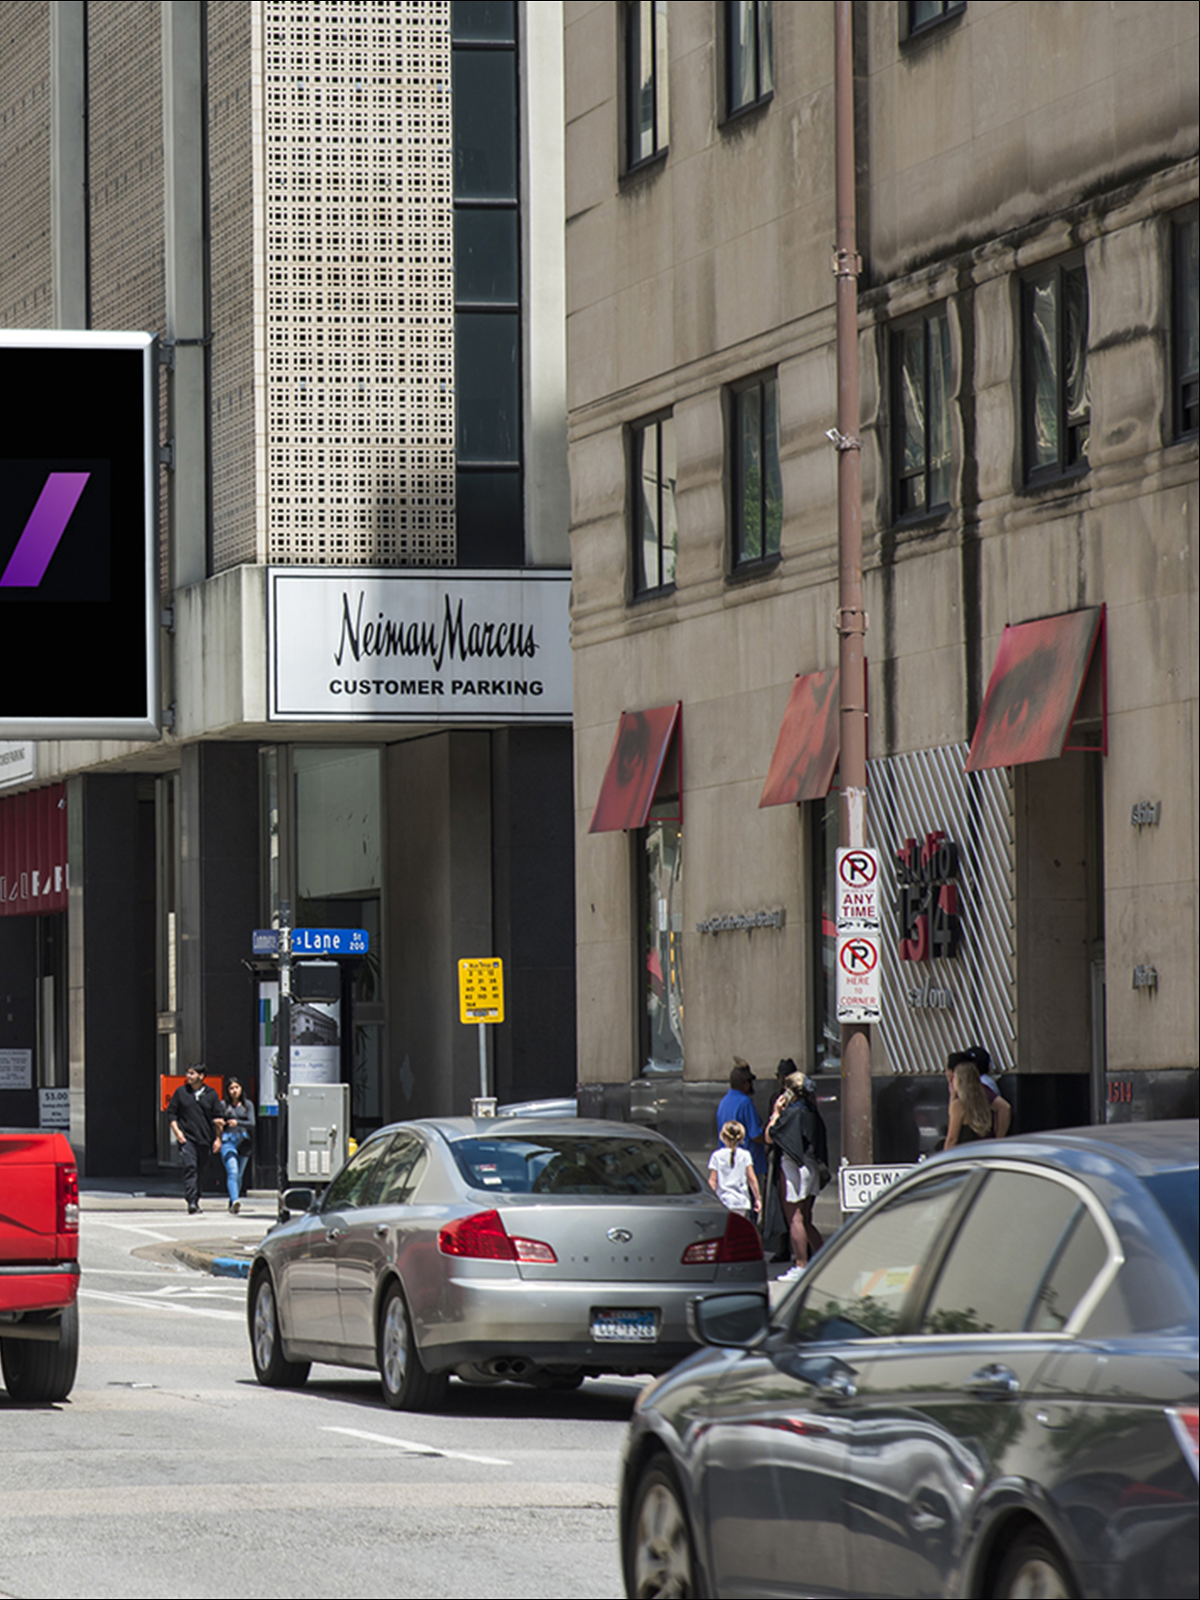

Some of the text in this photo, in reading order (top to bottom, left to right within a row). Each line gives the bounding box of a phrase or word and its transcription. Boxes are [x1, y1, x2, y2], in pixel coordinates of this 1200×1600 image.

[334, 591, 540, 672] Neiman Marcus
[329, 680, 544, 696] CUSTOMER PARKING
[843, 894, 873, 905] ANY
[842, 906, 875, 917] TIME
[304, 930, 341, 949] Lane
[349, 942, 365, 950] 200
[846, 977, 870, 985] HERE
[840, 997, 876, 1005] CORNER
[1108, 1082, 1132, 1102] 1514
